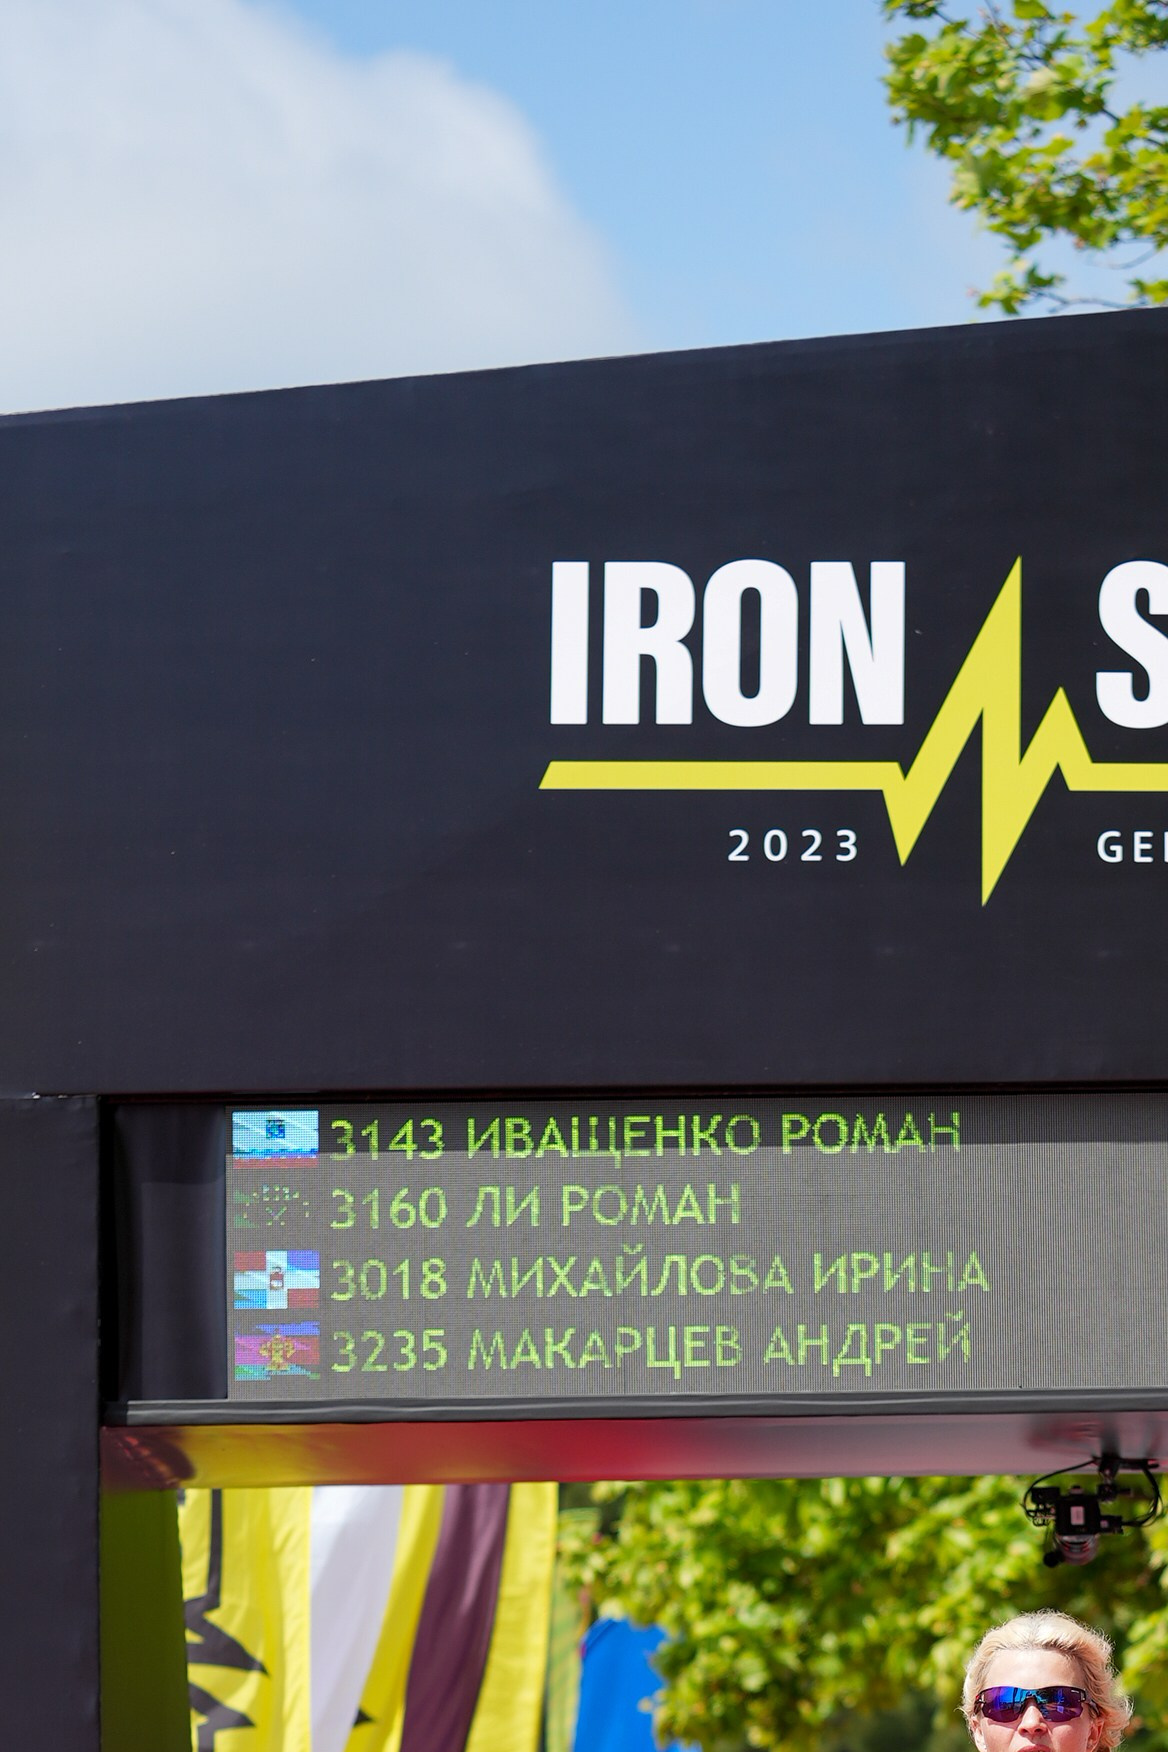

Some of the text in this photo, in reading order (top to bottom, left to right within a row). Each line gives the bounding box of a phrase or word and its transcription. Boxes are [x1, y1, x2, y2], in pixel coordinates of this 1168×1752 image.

[550, 559, 905, 727] IRON
[728, 829, 858, 862] 2023
[330, 1118, 446, 1161] 3143
[466, 1114, 762, 1167] ИВАЩЕНКО
[781, 1111, 961, 1154] РОМАН
[330, 1187, 448, 1230] 3160
[466, 1186, 541, 1228] ЛИ
[561, 1183, 741, 1227] РОМАН
[330, 1257, 448, 1300] 3018
[466, 1244, 794, 1300] МИХАЙЛОВА
[813, 1252, 990, 1295] ИРИНА
[330, 1328, 448, 1372] 3235
[466, 1325, 742, 1379] МАКАРЦЕВ
[763, 1311, 971, 1376] АНДРЕЙ
